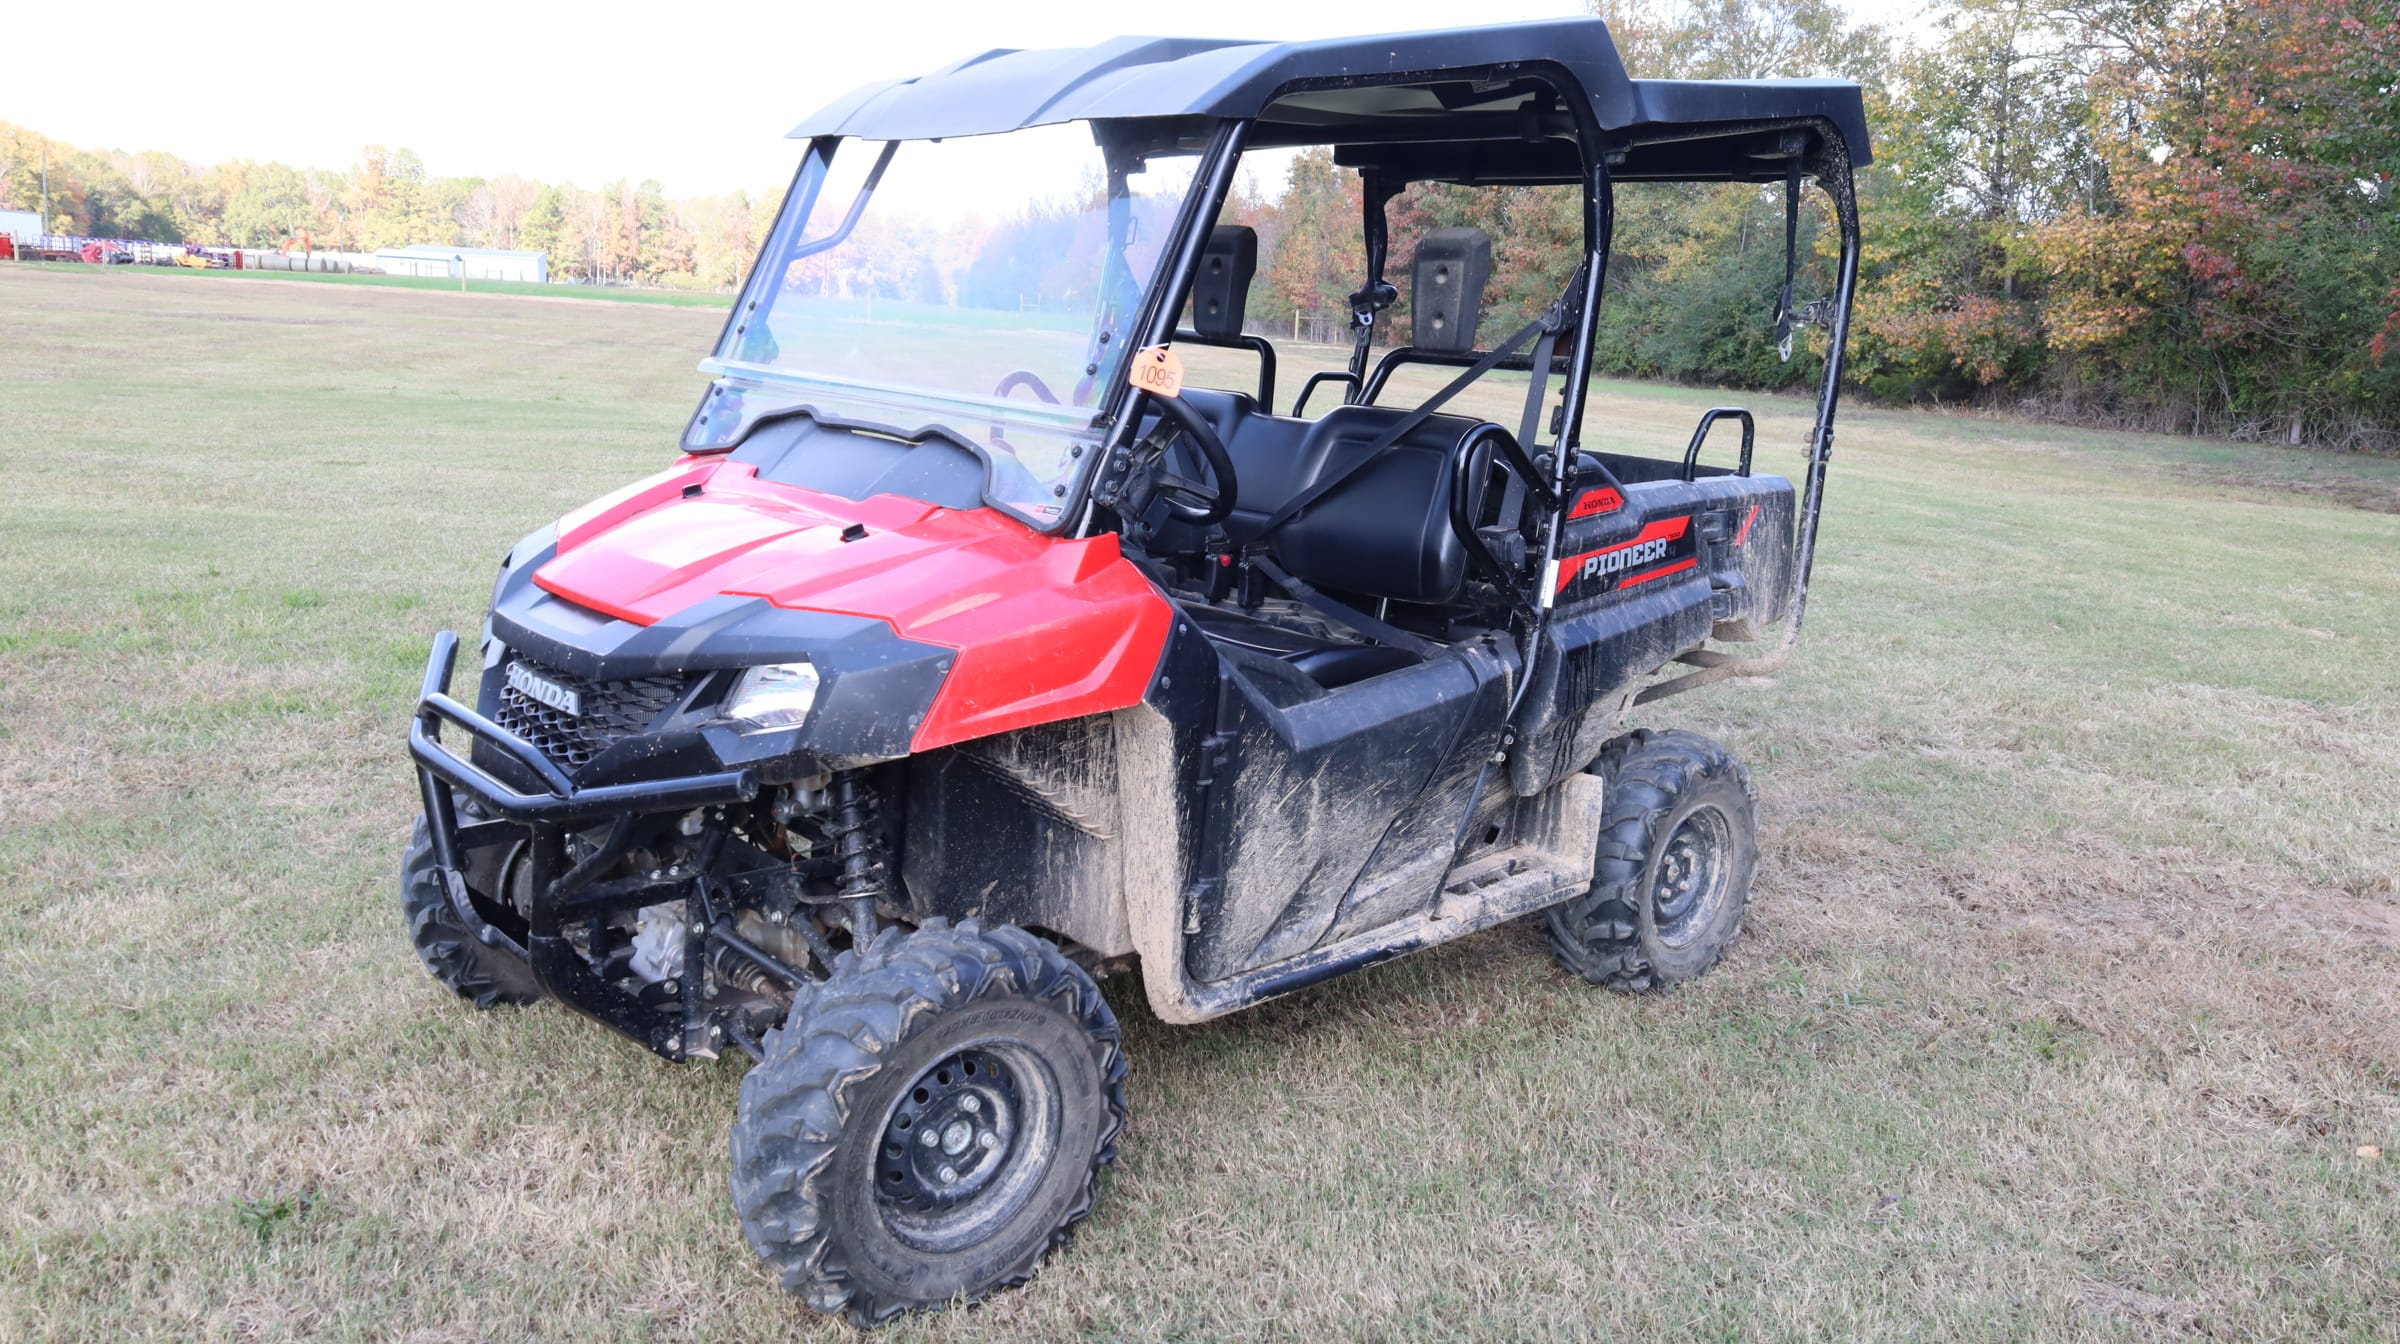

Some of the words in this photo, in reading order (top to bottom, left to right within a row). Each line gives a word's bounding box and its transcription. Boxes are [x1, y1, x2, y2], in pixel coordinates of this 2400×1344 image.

[1140, 365, 1176, 389] 1095
[1584, 496, 1615, 509] HONDA
[1584, 538, 1667, 580] PIONEER
[508, 664, 577, 717] HONDA
